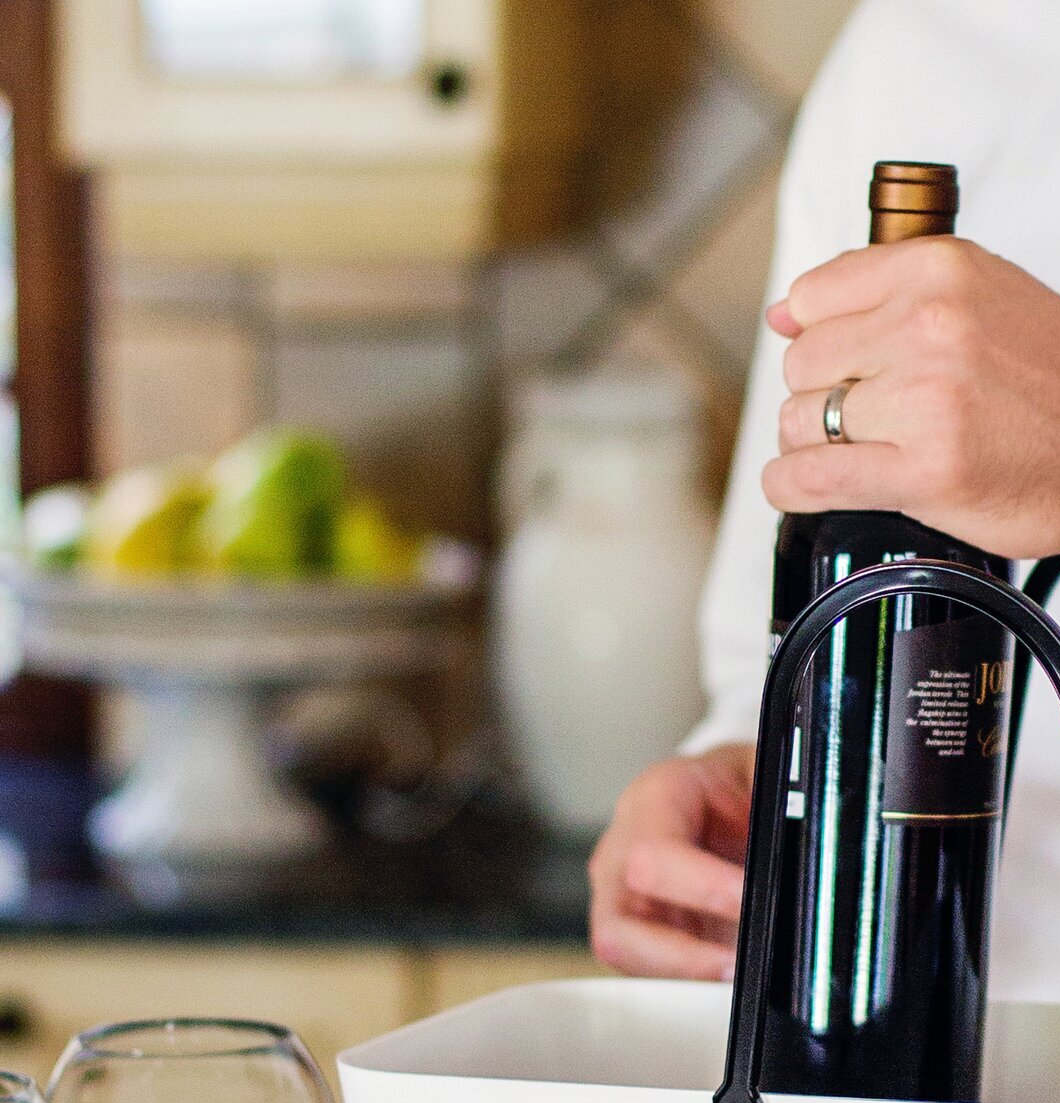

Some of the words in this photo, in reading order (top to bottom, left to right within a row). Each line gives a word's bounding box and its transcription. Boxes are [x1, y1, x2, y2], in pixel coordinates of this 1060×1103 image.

[929, 670, 943, 679] The
[943, 671, 971, 679] ultimate
[956, 690, 969, 698] This
[920, 699, 947, 708] limited
[947, 700, 969, 708] release
[905, 718, 918, 726] the
[932, 729, 944, 737] the
[925, 738, 953, 746] between
